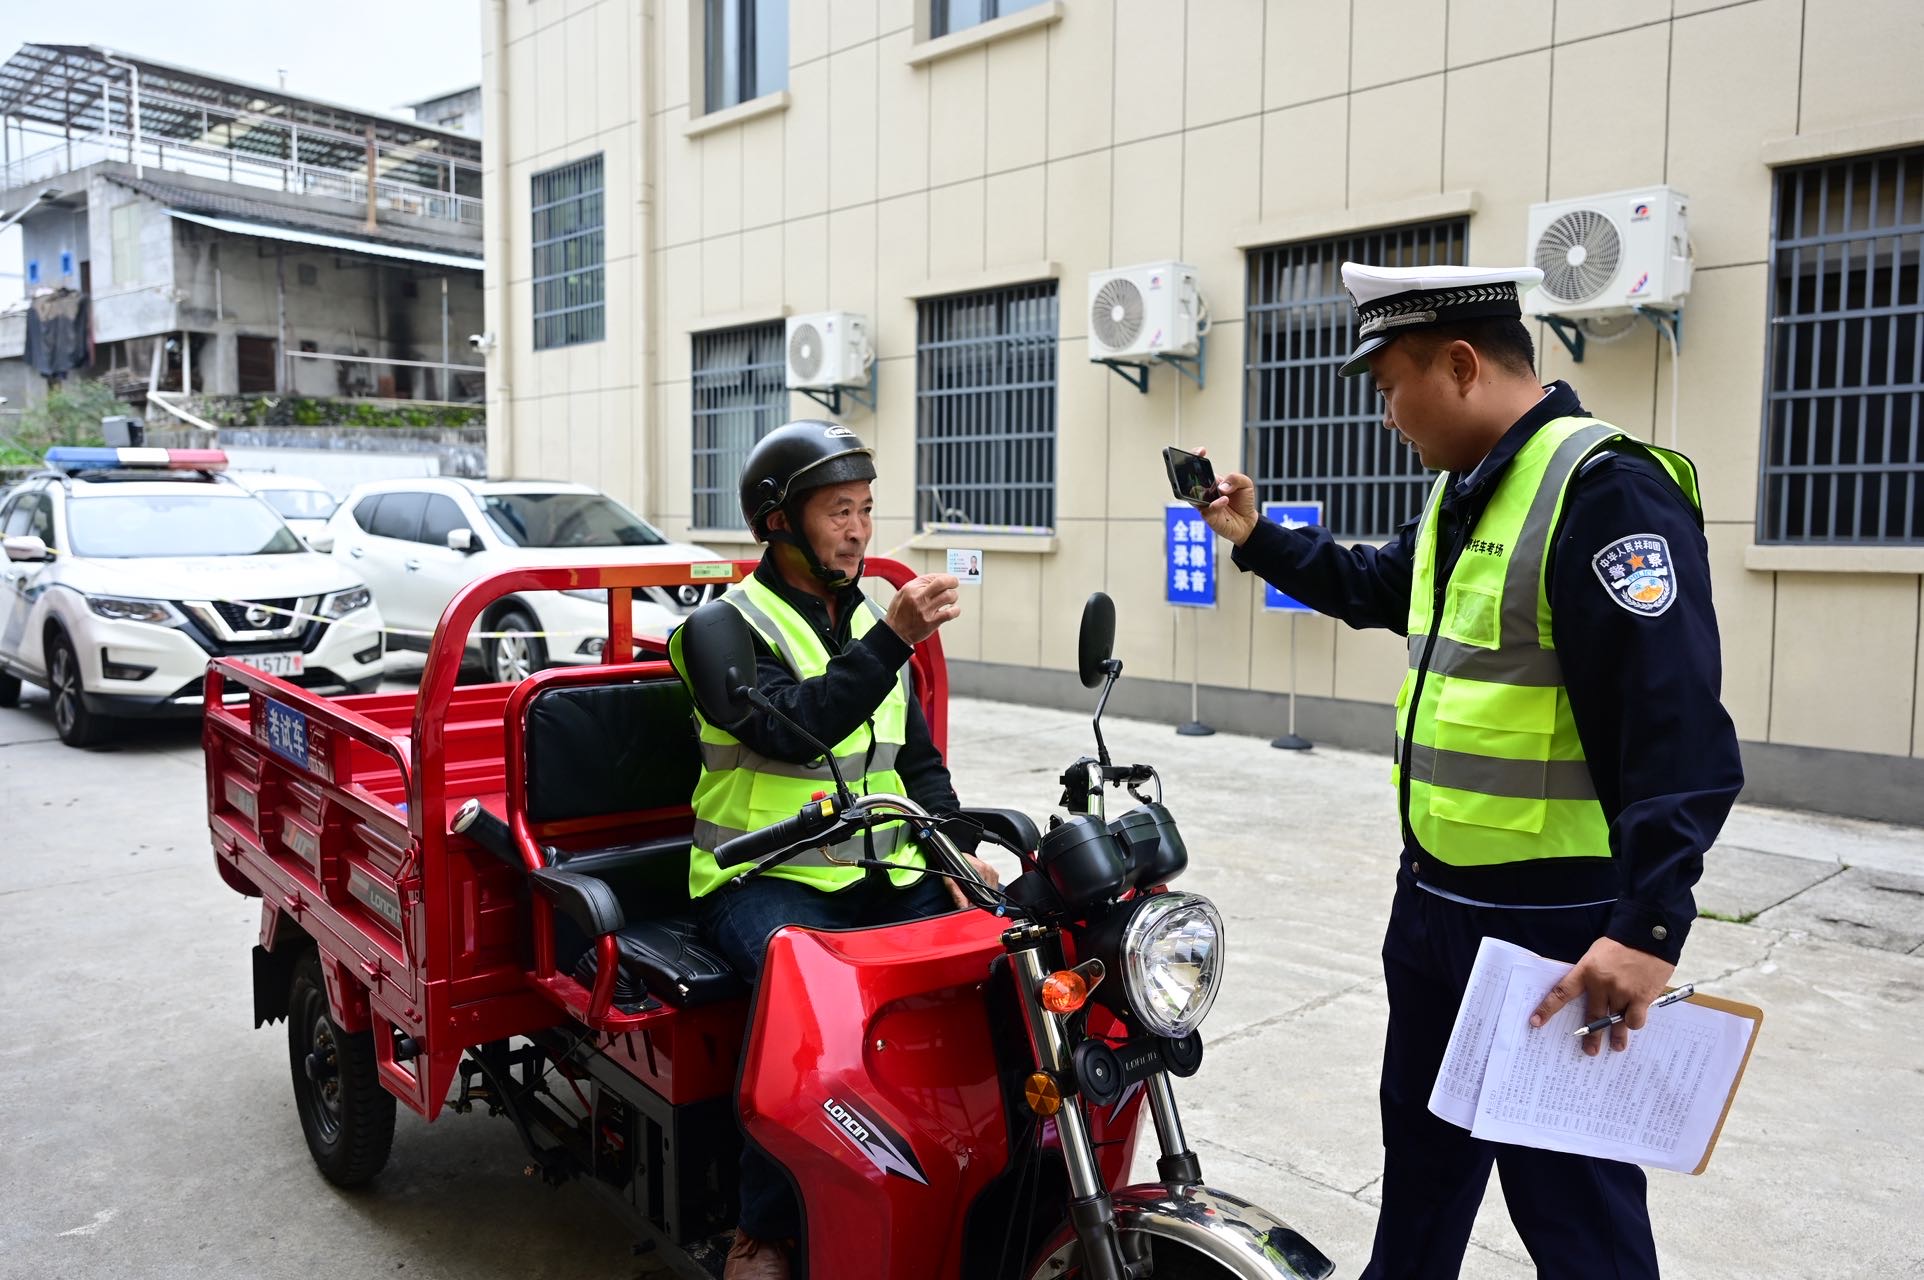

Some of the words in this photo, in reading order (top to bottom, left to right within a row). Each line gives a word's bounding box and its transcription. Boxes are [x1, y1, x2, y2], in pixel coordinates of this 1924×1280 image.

[1173, 519, 1206, 542] 全程
[1173, 544, 1207, 568] 录像
[1600, 540, 1661, 568] 中华人民共和国
[1173, 569, 1207, 592] 录音
[268, 707, 305, 759] 考试车
[823, 1098, 870, 1142] LONCIN
